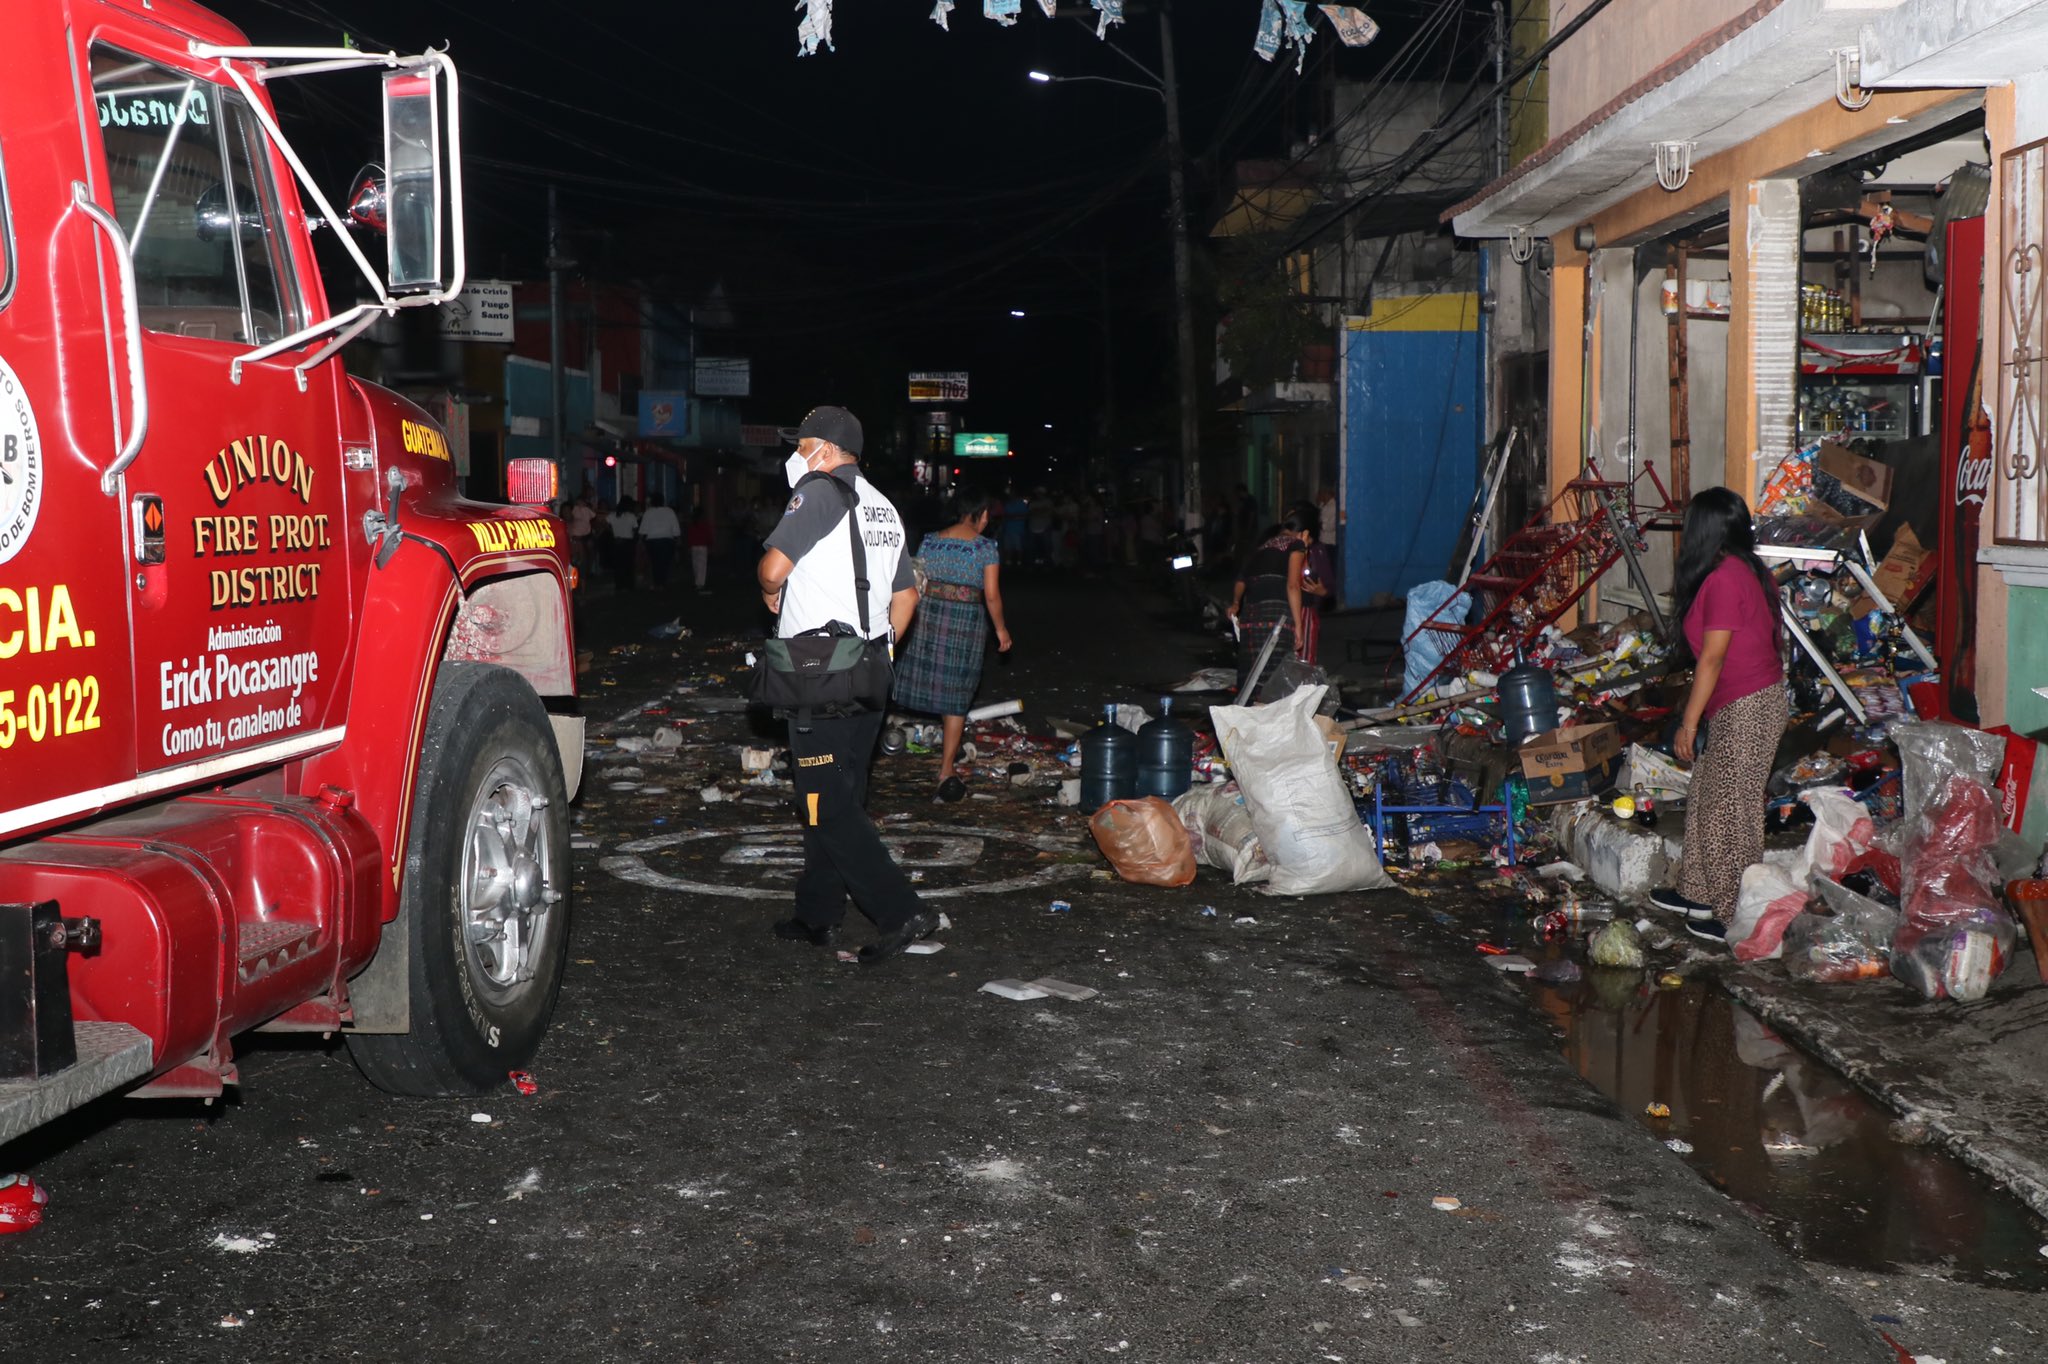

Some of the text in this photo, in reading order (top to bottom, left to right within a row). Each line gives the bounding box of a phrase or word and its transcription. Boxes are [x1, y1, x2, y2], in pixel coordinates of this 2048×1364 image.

[481, 300, 510, 310] Fuego
[482, 287, 508, 296] Cristo
[481, 311, 509, 320] Santo
[402, 418, 450, 462] GUATEMALA
[204, 434, 315, 504] UNION
[192, 513, 331, 555] FIRE PROT.
[466, 520, 511, 553] VILLA
[209, 562, 321, 608] DISTRICT
[160, 650, 319, 711] Erick Pocasangre
[161, 697, 302, 757] Como tu, canaleno de
